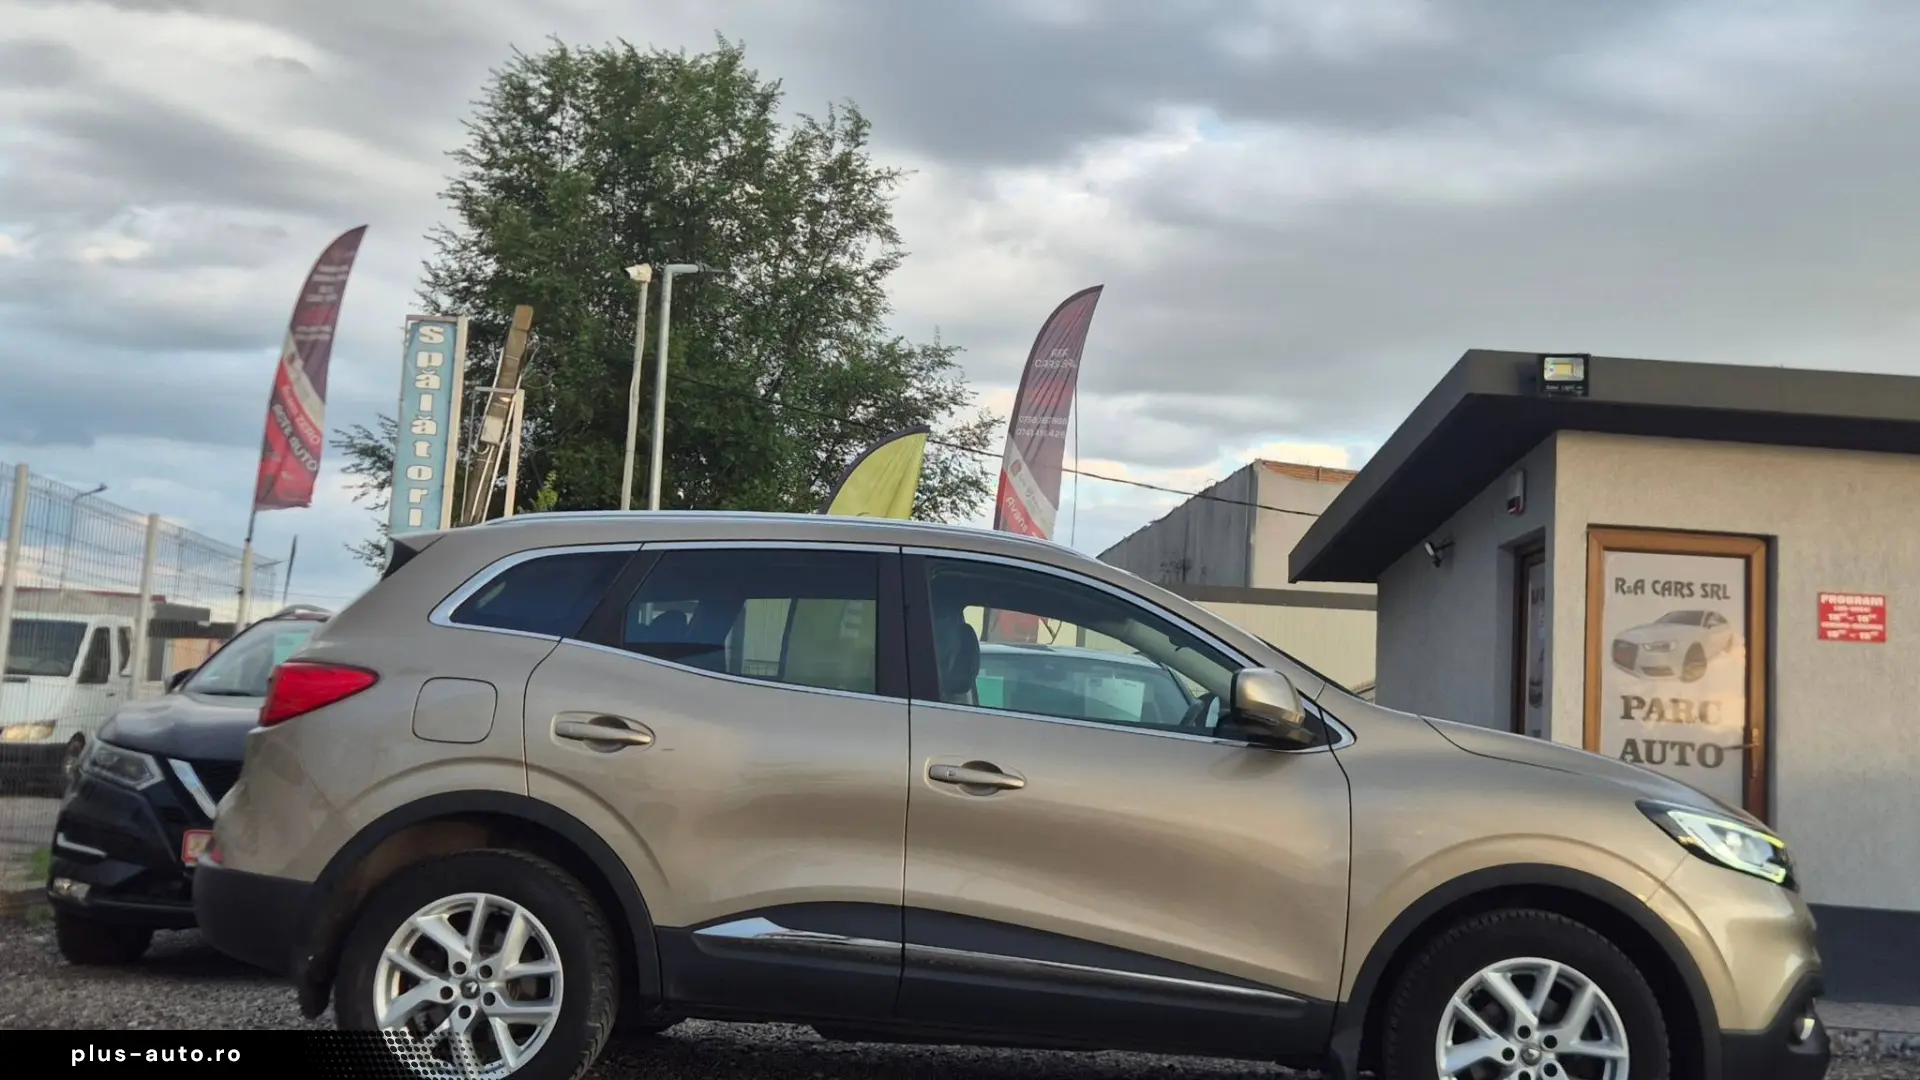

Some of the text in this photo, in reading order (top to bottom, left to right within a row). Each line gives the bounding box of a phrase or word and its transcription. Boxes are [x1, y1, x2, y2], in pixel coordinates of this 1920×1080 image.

[1651, 579, 1695, 598] CARS
[1700, 582, 1731, 600] SRL
[1820, 594, 1884, 607] PROGRAM
[1620, 695, 1722, 725] PARC
[1619, 737, 1725, 769] AUTO
